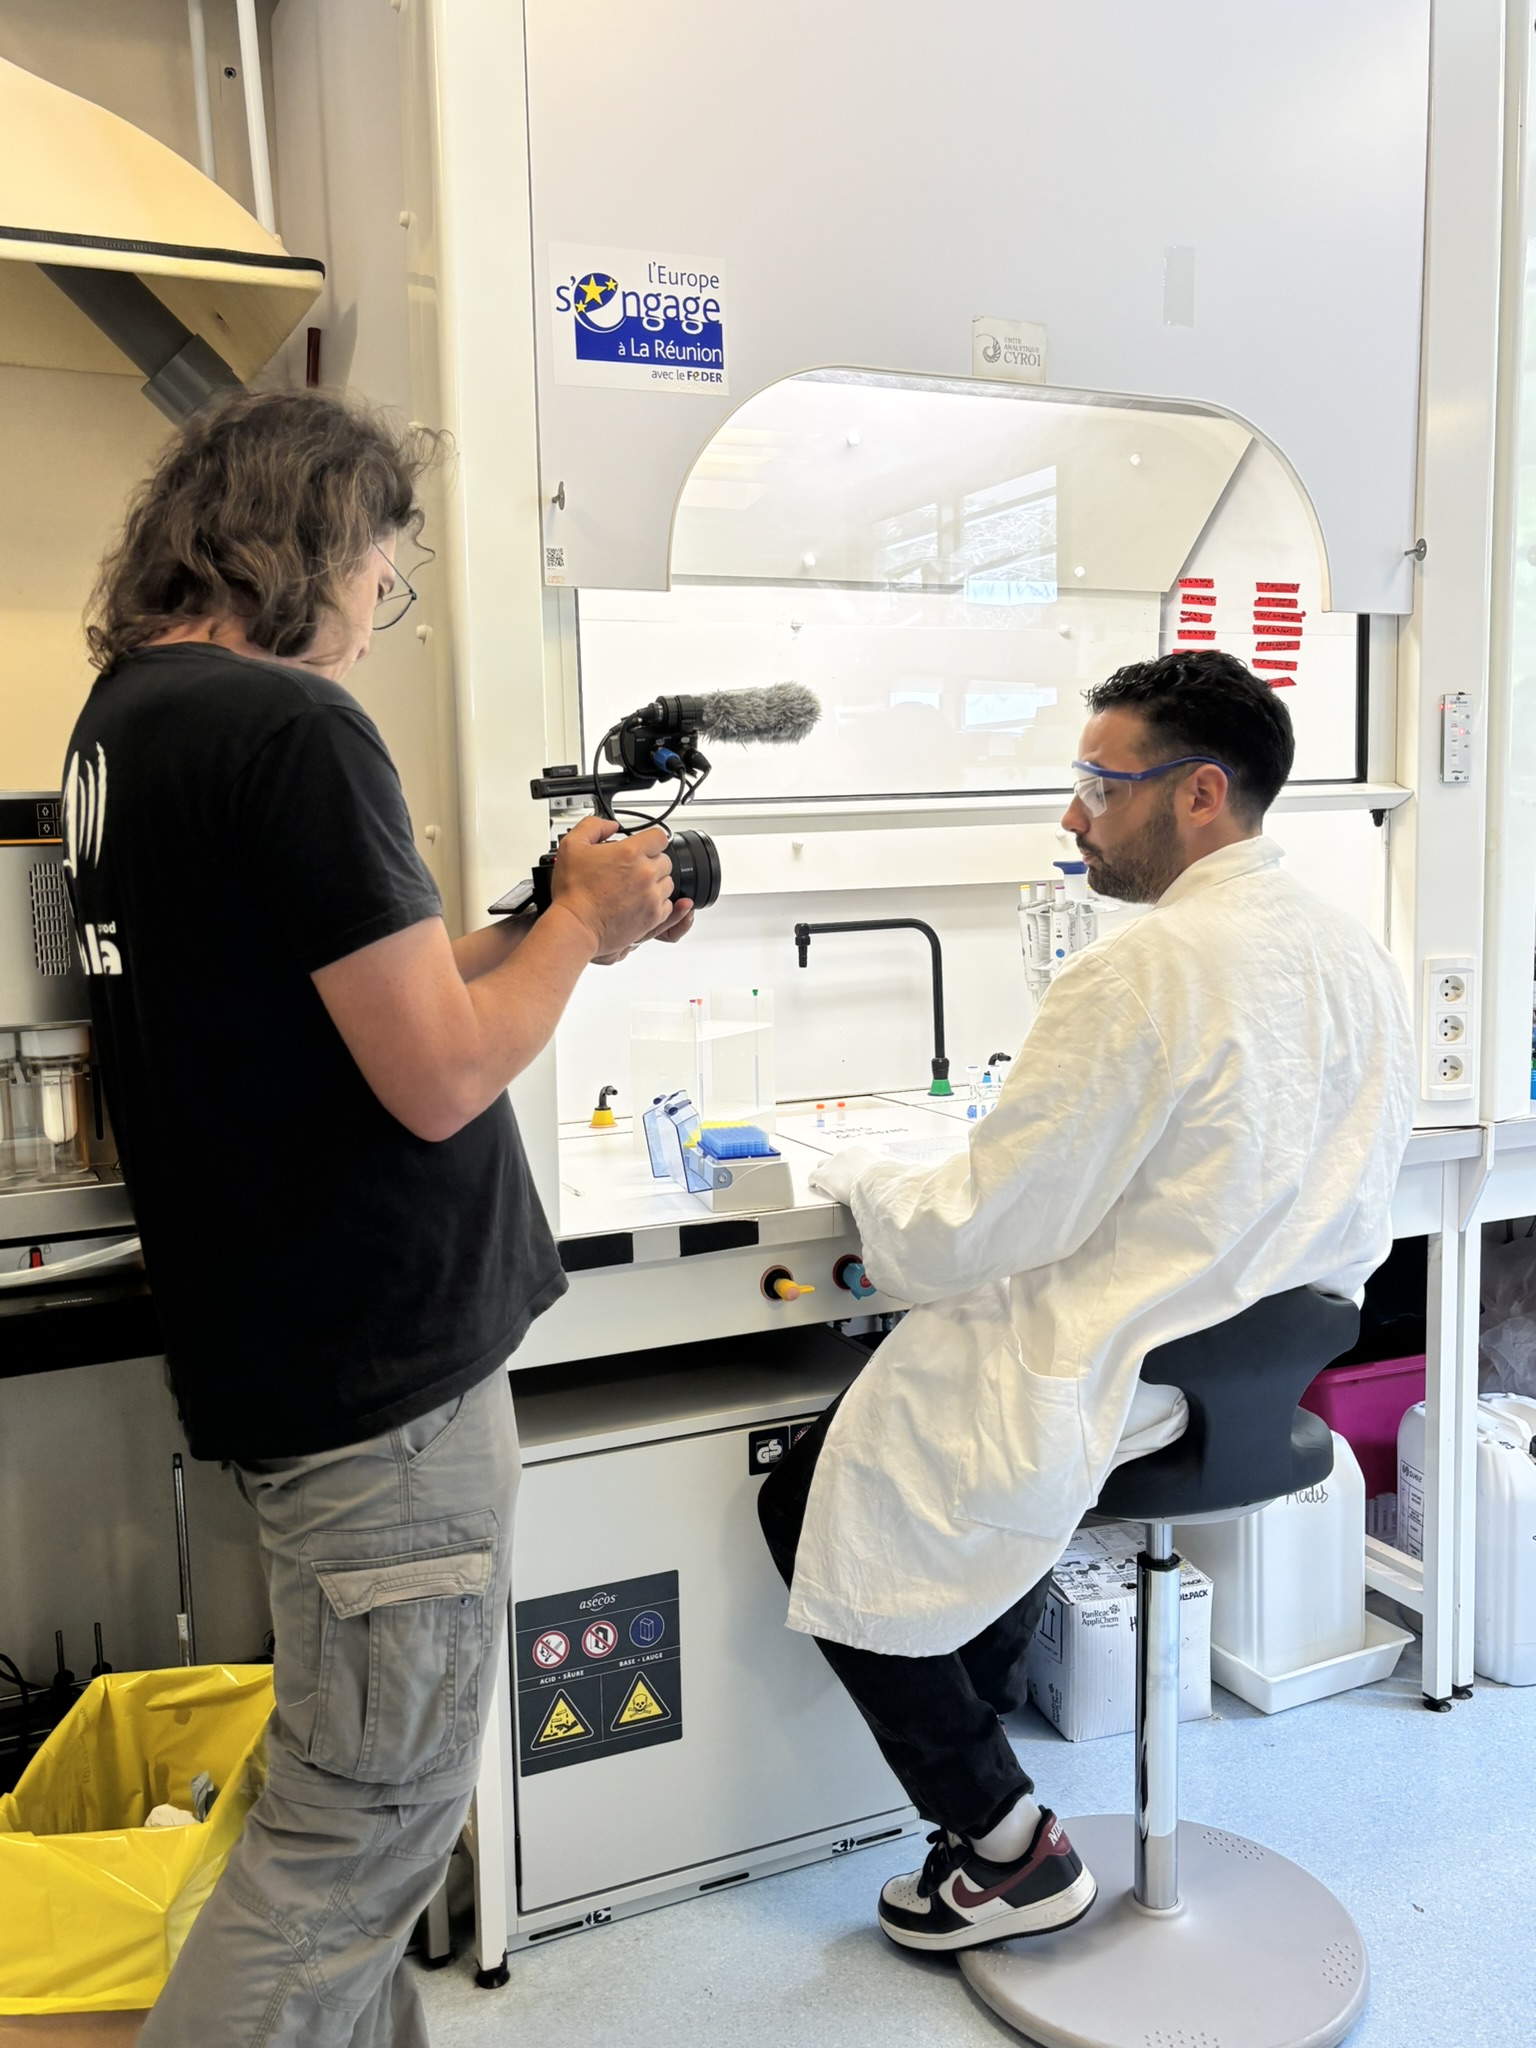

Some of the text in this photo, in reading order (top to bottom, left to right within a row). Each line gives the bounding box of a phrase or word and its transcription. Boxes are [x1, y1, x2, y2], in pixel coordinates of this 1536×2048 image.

[648, 261, 720, 293] l'Europe
[618, 337, 723, 363] à La Réunion
[1003, 351, 1041, 367] CYROI
[651, 370, 674, 380] avec
[676, 369, 685, 381] le
[579, 1593, 617, 1610] asecos
[1081, 1615, 1119, 1627] AppliChem
[619, 1652, 664, 1667] BASE LAUGE
[539, 1675, 556, 1685] ACID
